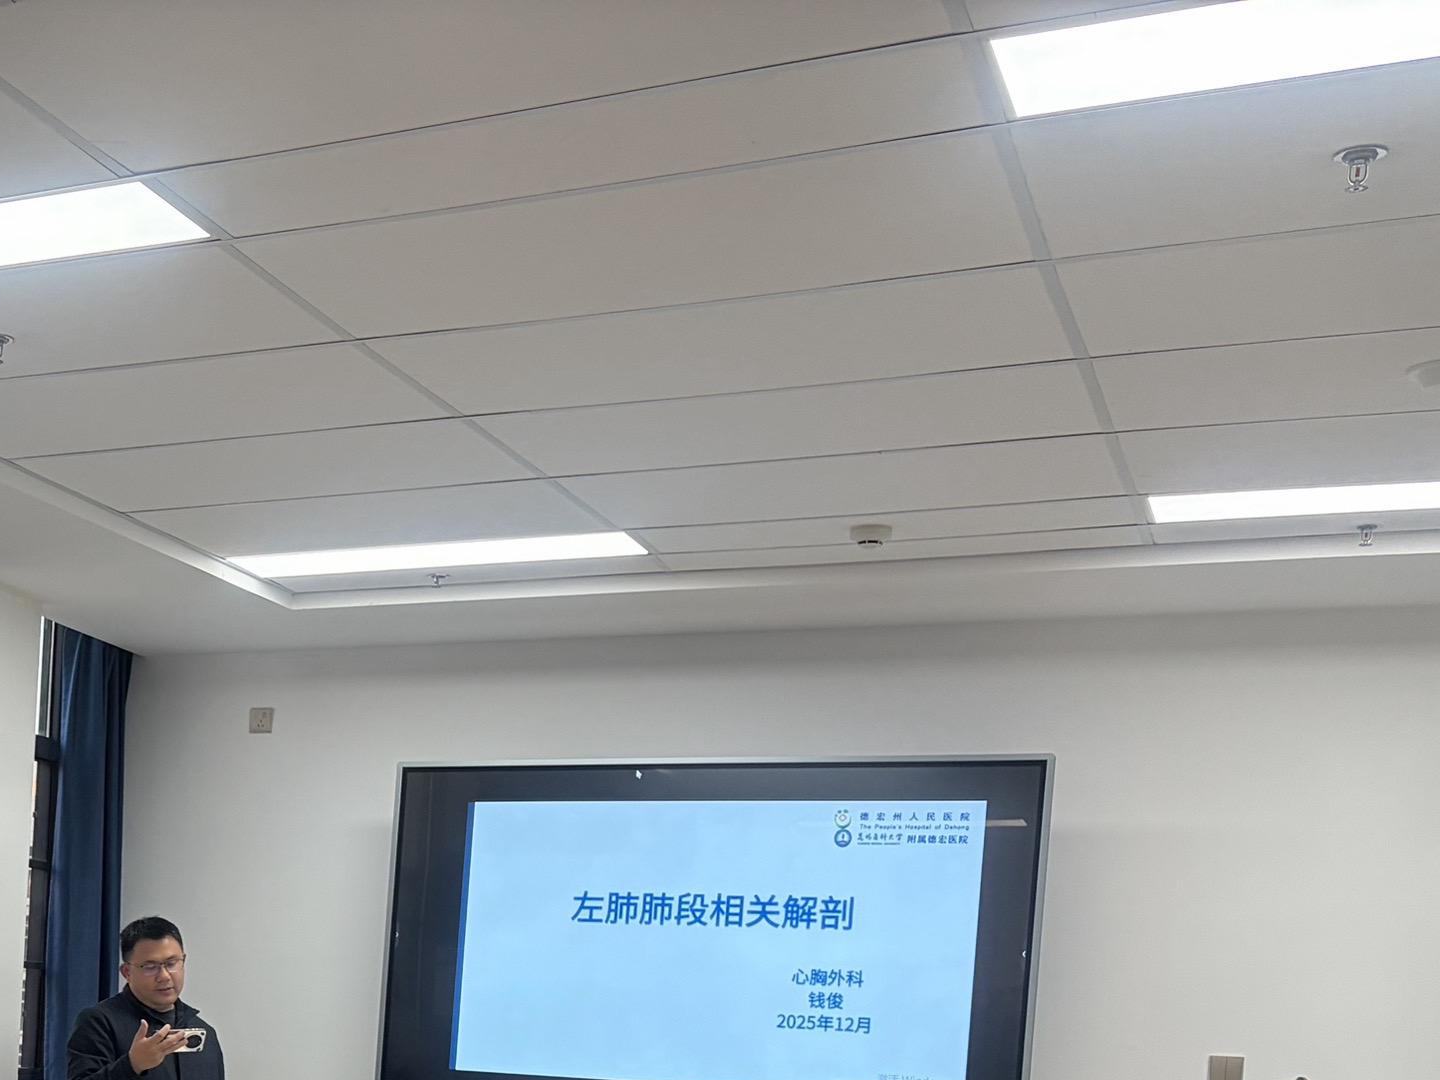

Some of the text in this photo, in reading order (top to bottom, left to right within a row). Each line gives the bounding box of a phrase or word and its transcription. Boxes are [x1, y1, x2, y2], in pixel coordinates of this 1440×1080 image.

[570, 890, 855, 931] 左肺肺段相关解剖
[791, 968, 864, 988] 心胸外科
[807, 991, 844, 1010] 钱俊
[776, 1013, 872, 1035] 2025年12月
